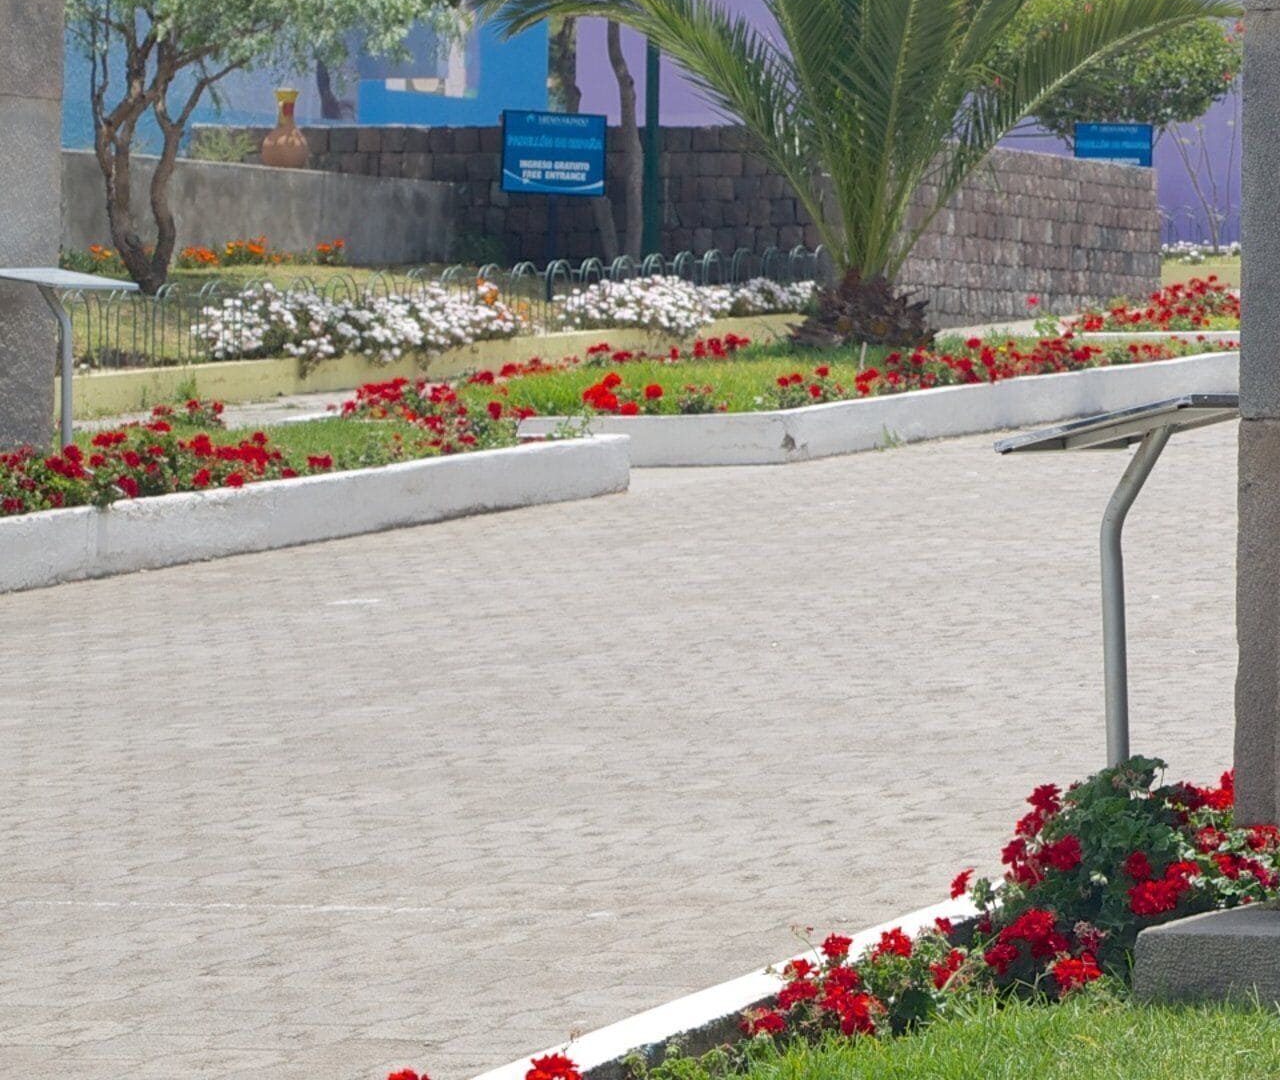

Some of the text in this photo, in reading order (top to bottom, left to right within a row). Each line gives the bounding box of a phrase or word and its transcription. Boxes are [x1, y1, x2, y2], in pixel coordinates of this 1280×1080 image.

[519, 160, 590, 172] INGRESO GRATUITO
[522, 170, 587, 182] FREE ENTRANCE
